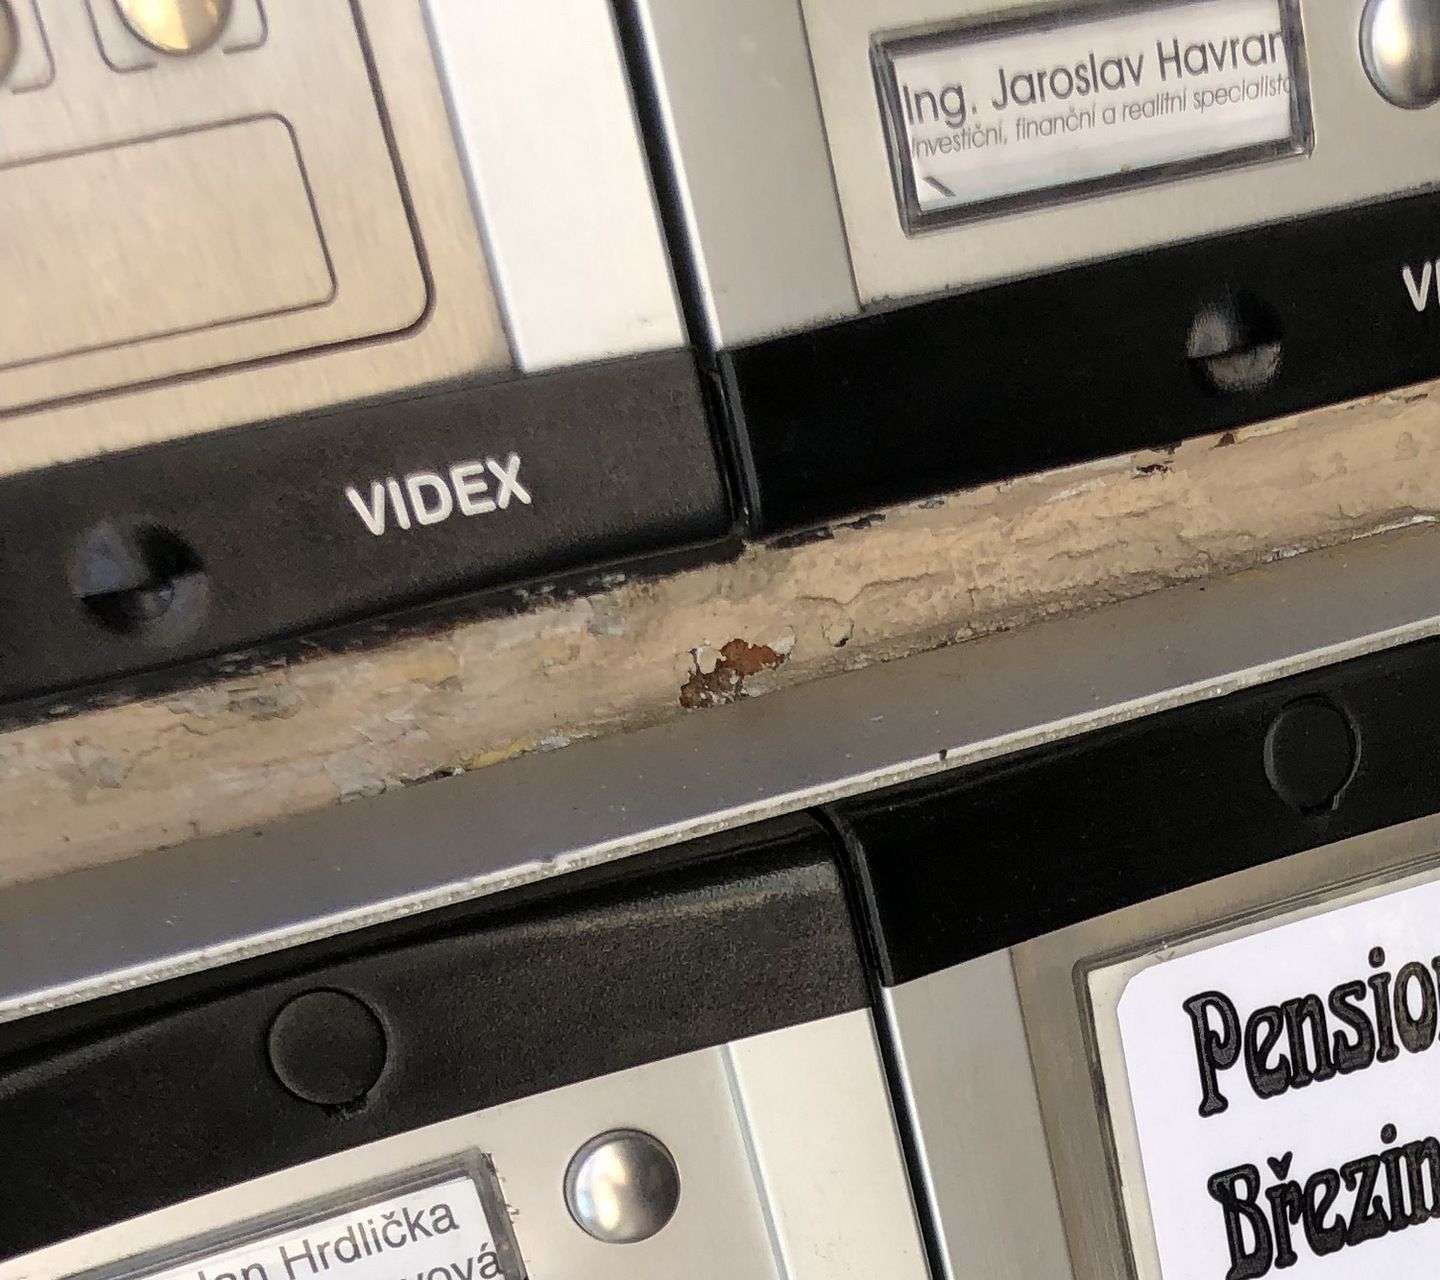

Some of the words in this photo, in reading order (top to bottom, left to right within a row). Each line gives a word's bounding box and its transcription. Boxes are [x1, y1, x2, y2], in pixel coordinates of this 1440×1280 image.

[902, 81, 977, 130] Ing.
[991, 50, 1144, 111] Jaroslav
[1102, 104, 1116, 125] a
[345, 453, 532, 536] VIDEX
